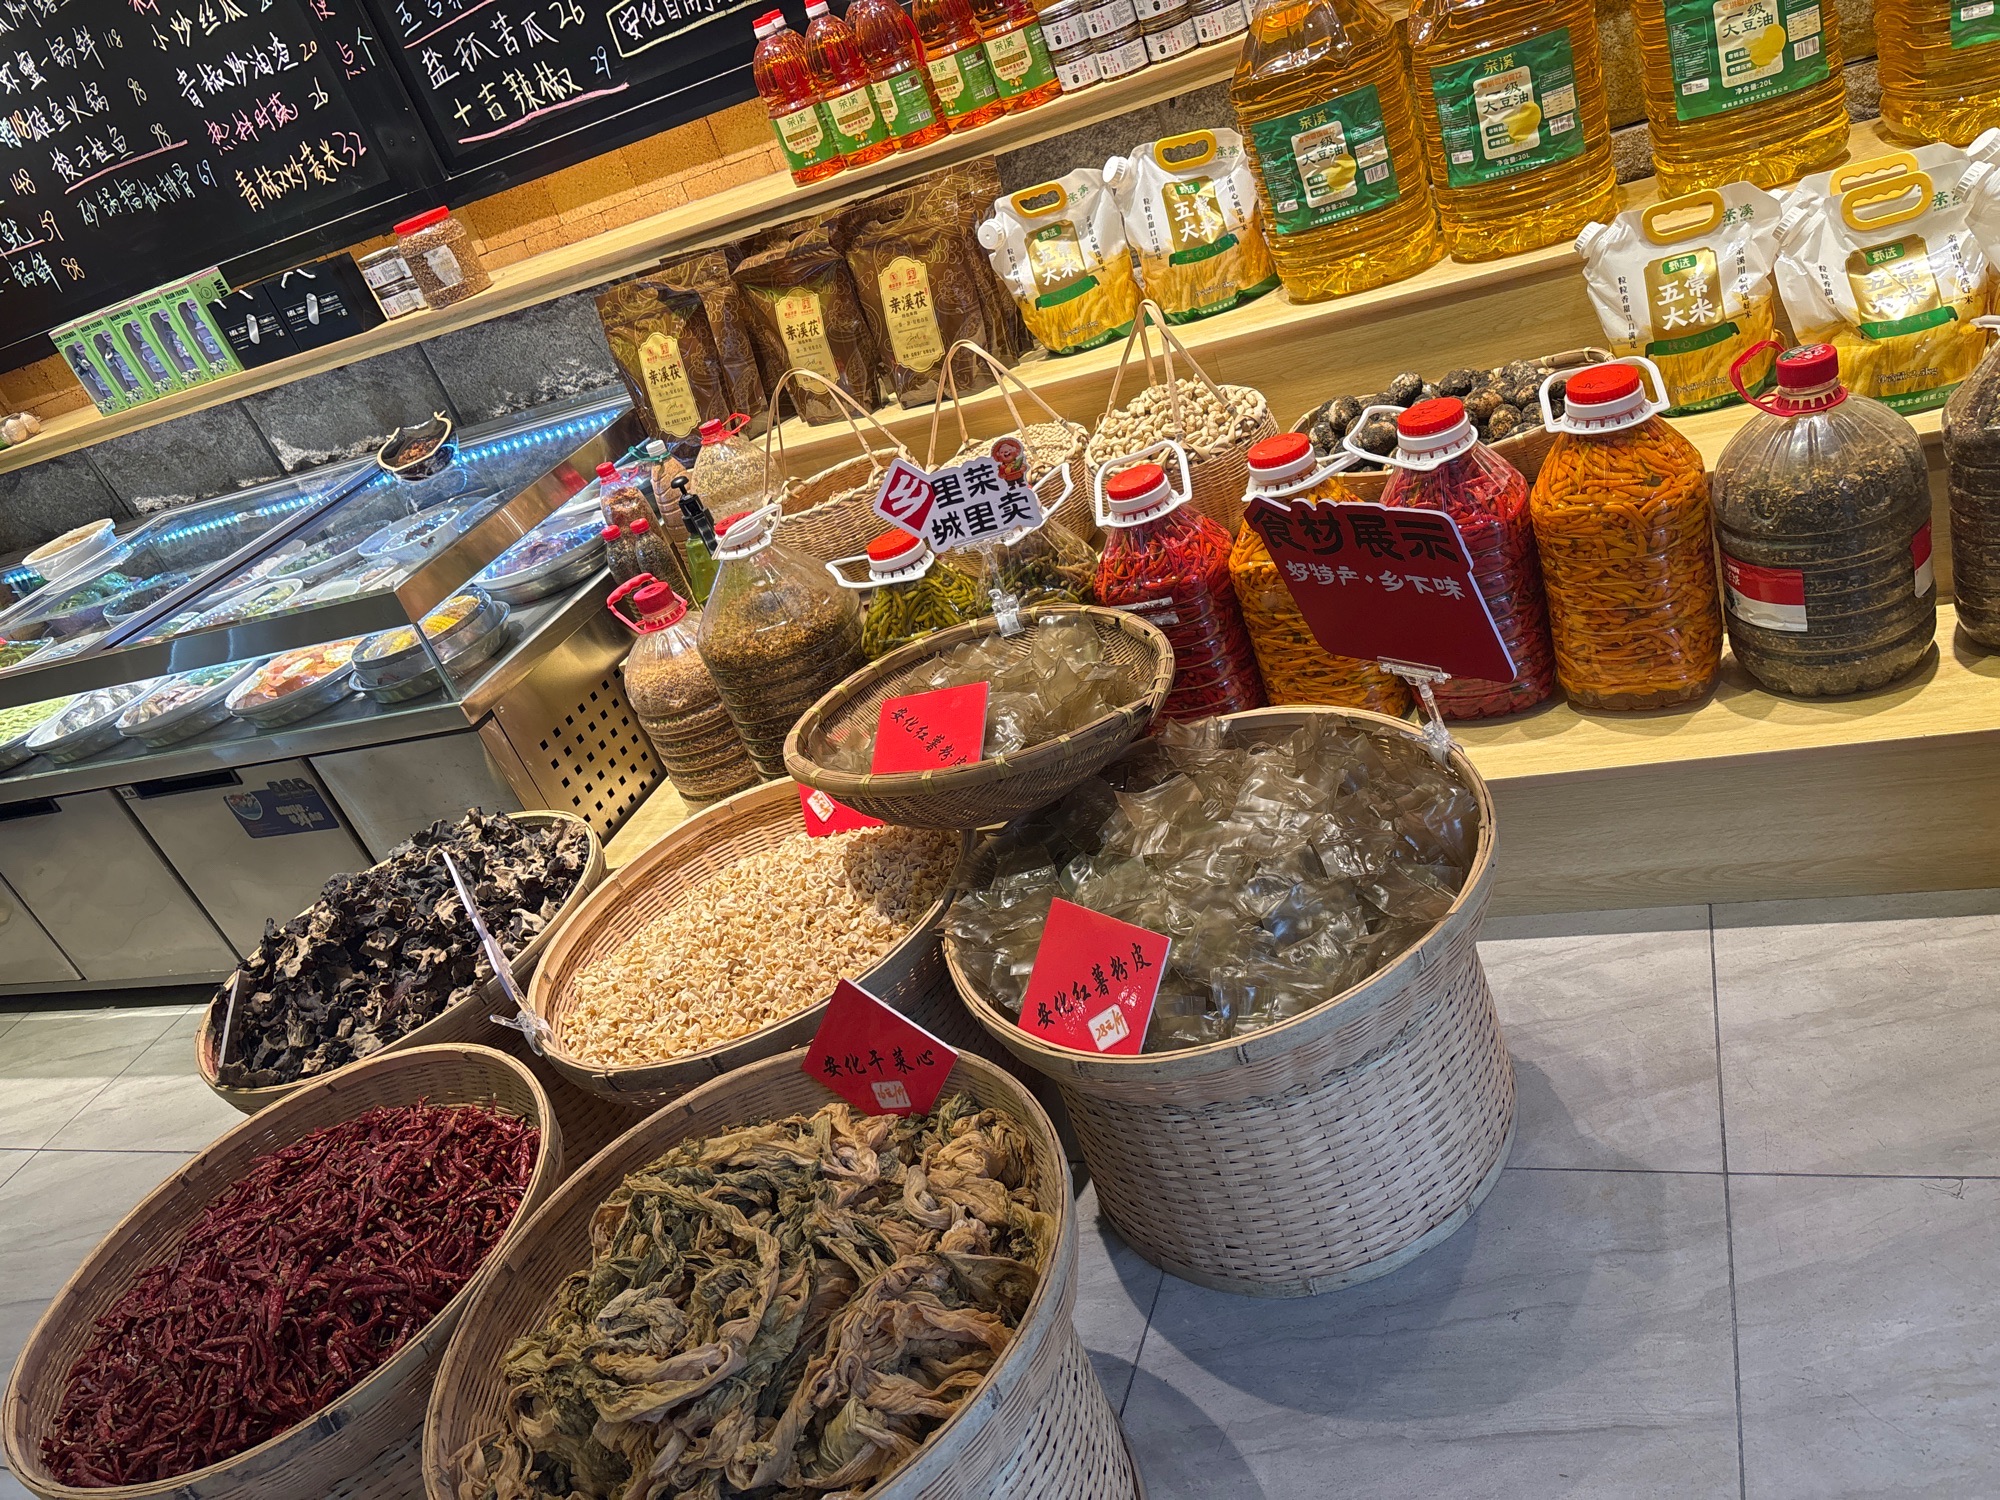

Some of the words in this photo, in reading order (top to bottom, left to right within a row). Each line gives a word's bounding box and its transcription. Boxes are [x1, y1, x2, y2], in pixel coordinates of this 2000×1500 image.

[549, 1, 586, 29] 26
[1722, 12, 1774, 39] 大豆油
[1726, 2, 1766, 21] 一级
[103, 29, 123, 48] 118
[299, 41, 317, 61] 20
[590, 46, 611, 79] 29
[127, 78, 147, 106] 98
[308, 77, 328, 110] 26
[1483, 92, 1529, 114] 大豆油
[1486, 81, 1521, 97] 一级
[150, 123, 172, 150] 98
[331, 131, 367, 167] 32
[1302, 145, 1343, 166] 大豆油
[9, 168, 36, 195] 148
[197, 160, 217, 188] 69
[38, 210, 64, 241] 59
[1179, 216, 1219, 243] 大米
[61, 257, 85, 280] 88
[1042, 258, 1080, 286] 大米
[1657, 268, 1709, 306] 五常
[1662, 298, 1715, 331] 大米
[931, 486, 1034, 546] 城里卖
[1252, 506, 1459, 563] 食材展示
[823, 1046, 935, 1077] 安化干菜心
